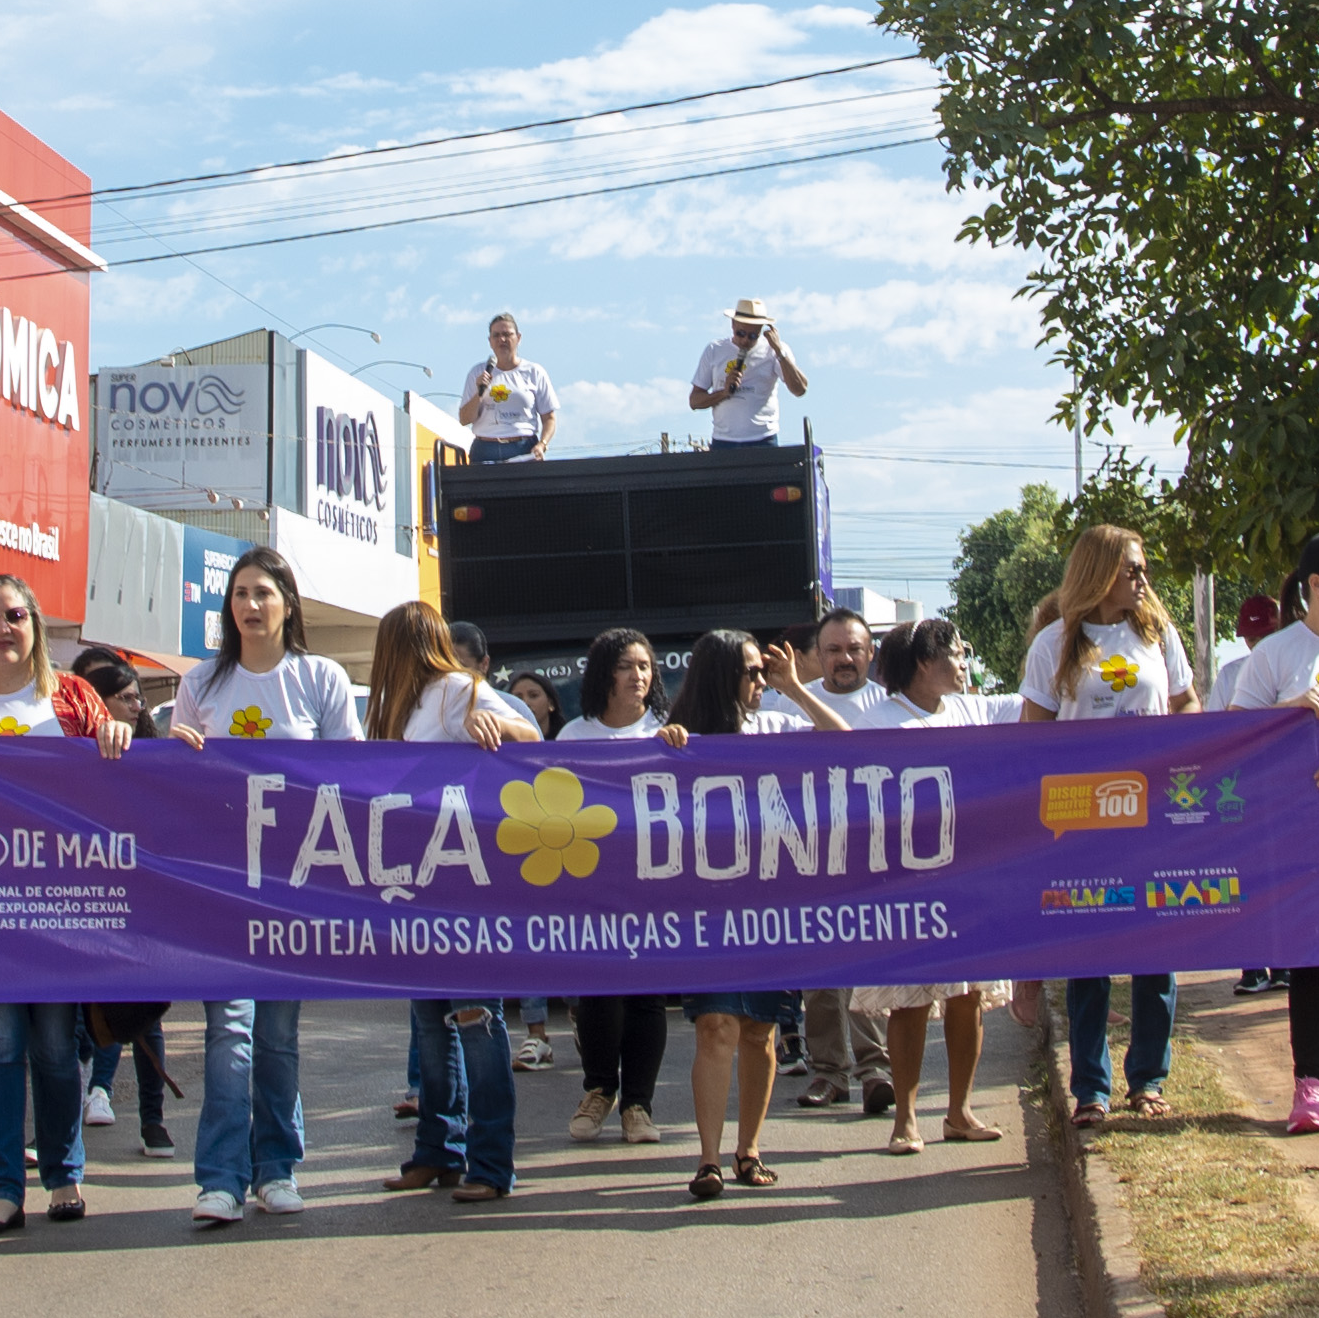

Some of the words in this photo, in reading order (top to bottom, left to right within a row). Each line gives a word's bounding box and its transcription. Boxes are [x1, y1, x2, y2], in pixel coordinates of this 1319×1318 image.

[110, 373, 137, 382] SUPER
[111, 417, 226, 431] COSMÉTICOS
[112, 437, 172, 448] PERFUMES
[184, 436, 251, 447] PRESENTES
[317, 499, 378, 545] COSMÉTICOS
[19, 527, 33, 554] no
[545, 665, 572, 678] (63)
[1048, 785, 1094, 800] DISQUE
[1047, 798, 1092, 812] DIREITOS
[1097, 793, 1139, 818] 100
[247, 774, 491, 904] FAÇA
[631, 765, 956, 881] BONITO
[13, 828, 47, 869] DE
[56, 831, 138, 870] MAIO
[1153, 868, 1197, 879] GOVERNO
[1199, 866, 1239, 877] FEDERAL
[1050, 877, 1124, 888] PREFEITURA
[25, 887, 43, 898] DE
[45, 886, 105, 898] COMBATE
[108, 886, 127, 898] AO
[1041, 886, 1136, 908] PALMAS
[1146, 877, 1242, 909] BRASIL
[84, 900, 132, 914] SEXUAL
[19, 917, 27, 930] E
[30, 917, 127, 930] ADOLESCENTES
[248, 918, 377, 956] PROTEJA
[390, 916, 514, 955] NOSSAS
[526, 911, 682, 959] CRIANÇAS
[695, 910, 709, 948] E
[723, 901, 958, 947] ADOLESCENTES.
